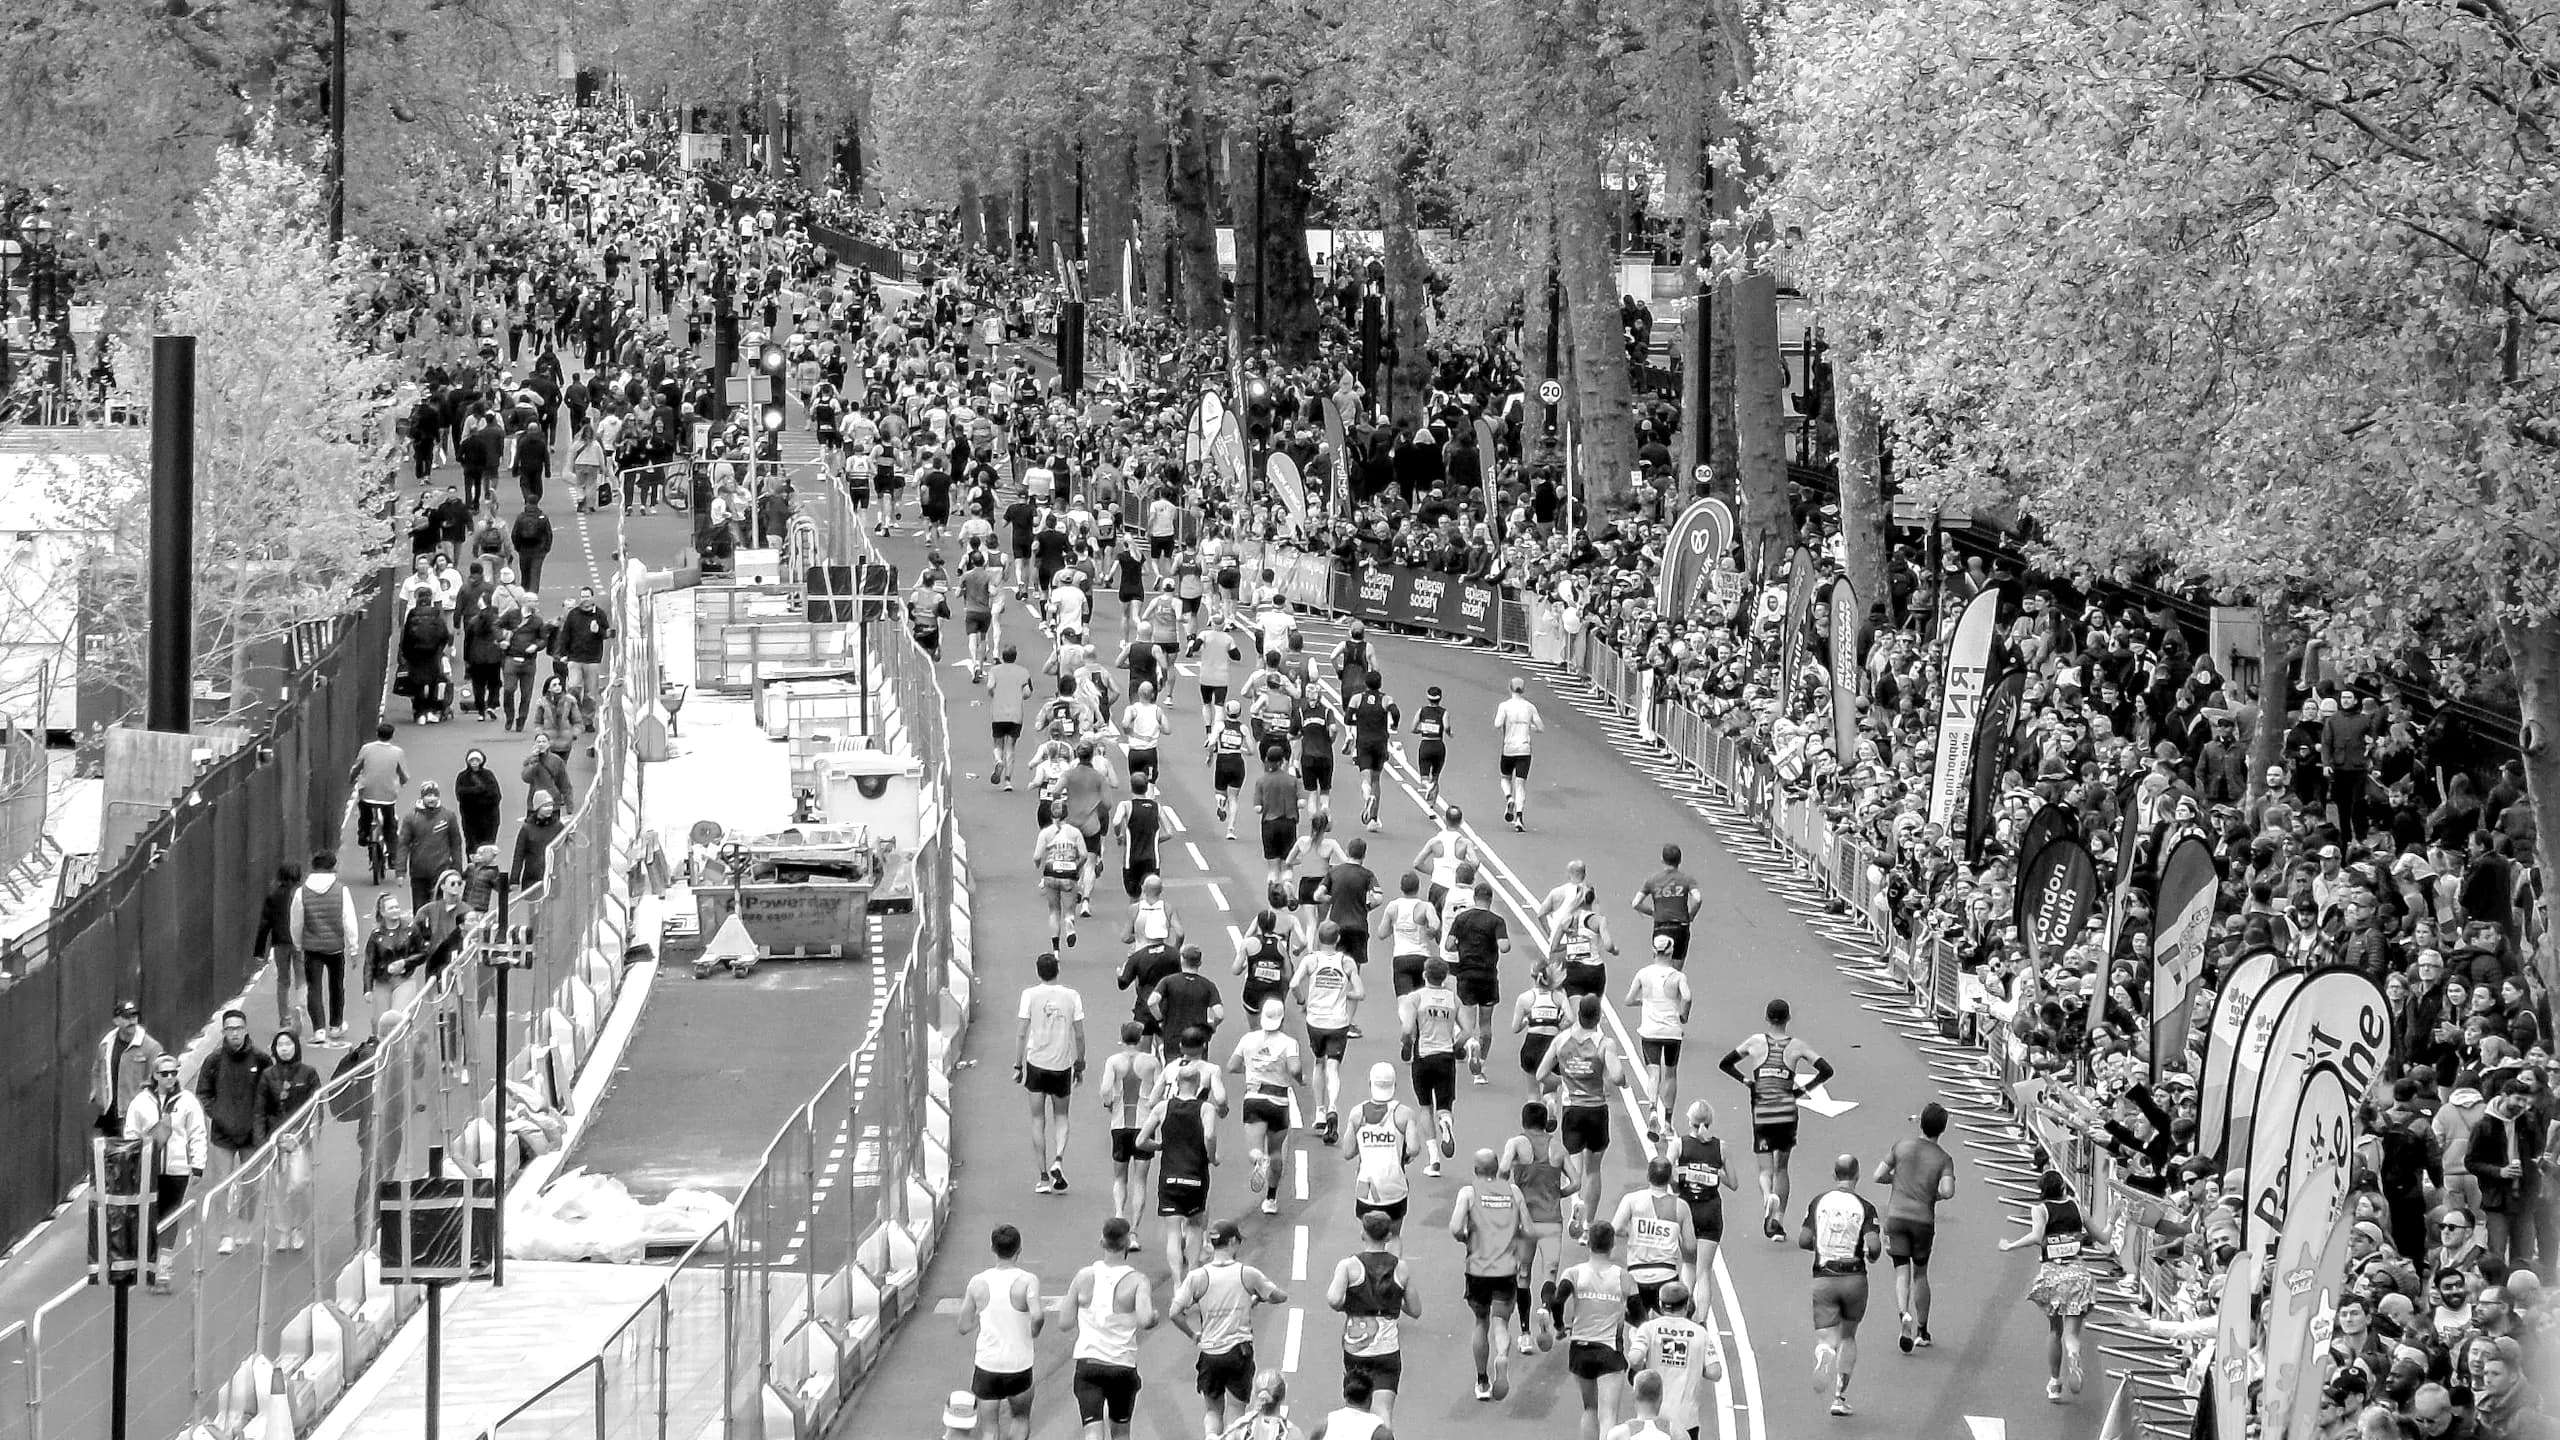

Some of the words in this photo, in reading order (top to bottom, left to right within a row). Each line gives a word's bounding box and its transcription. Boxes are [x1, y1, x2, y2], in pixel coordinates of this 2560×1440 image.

[1542, 386, 1560, 397] 20
[1414, 576, 1445, 598] epilepsy
[1409, 593, 1438, 613] society
[1461, 602, 1485, 622] society
[1837, 600, 1845, 687] MUSCULAR
[1844, 599, 1852, 691] DYSTROPHY
[1654, 885, 1684, 898] 26.2
[744, 895, 841, 914] Powerday
[2037, 864, 2066, 943] London
[2048, 889, 2077, 946] Youth
[1362, 1131, 1396, 1143] Phab
[1637, 1219, 1671, 1238] Bliss
[1657, 1327, 1695, 1337] LLOYD
